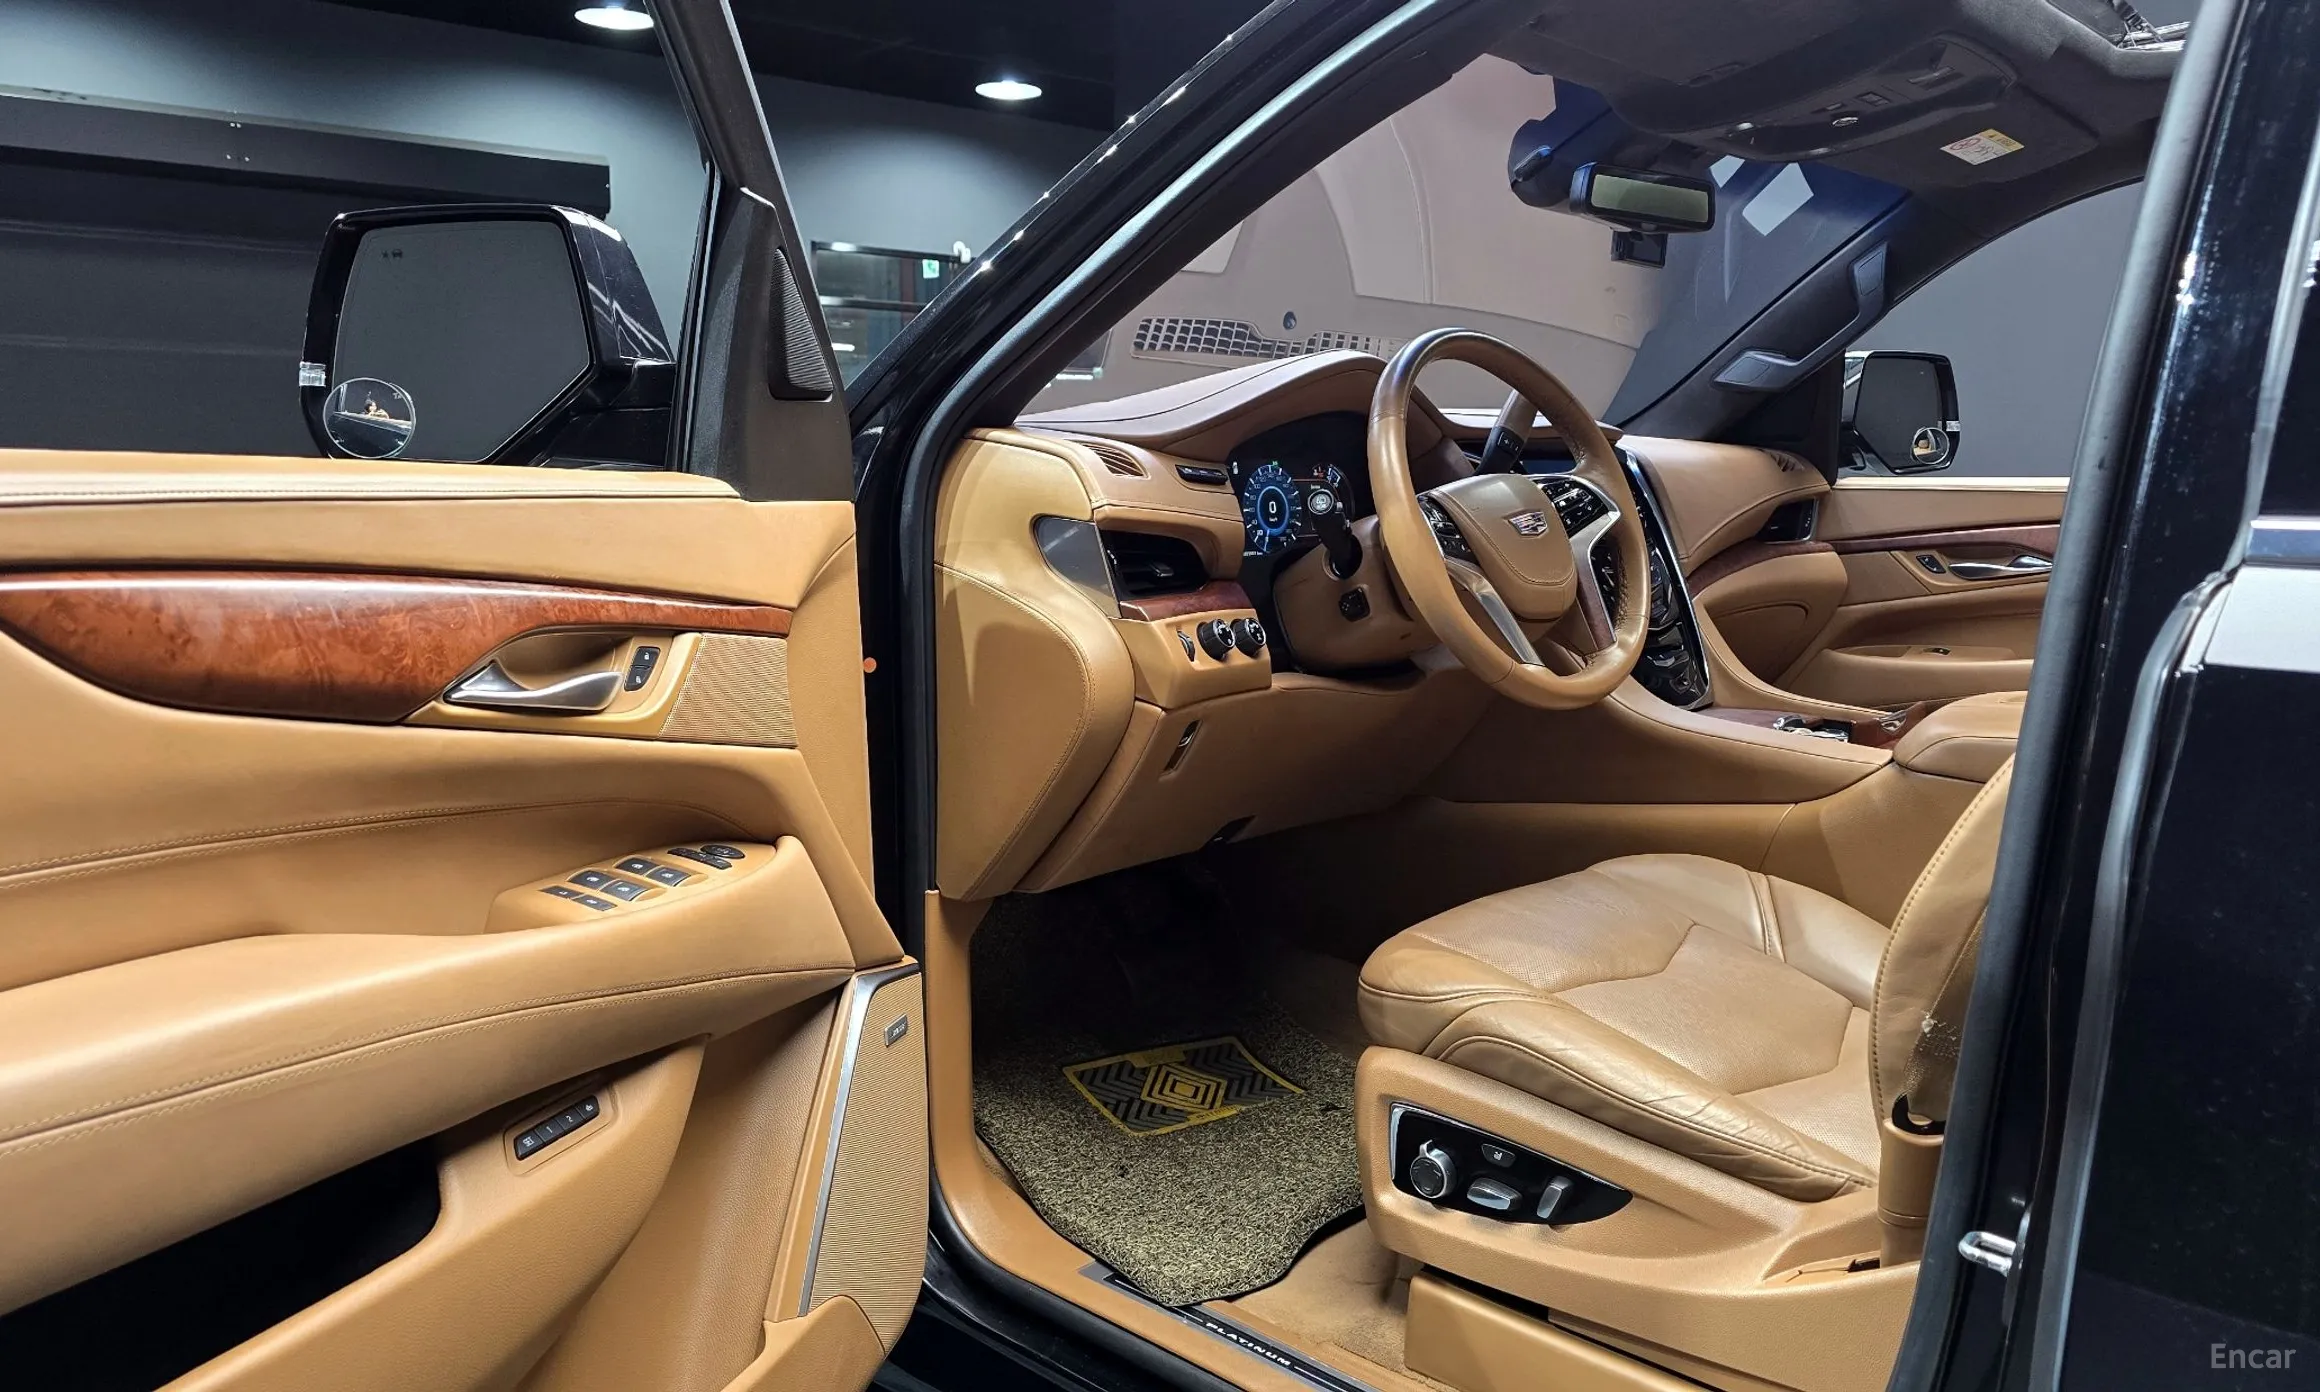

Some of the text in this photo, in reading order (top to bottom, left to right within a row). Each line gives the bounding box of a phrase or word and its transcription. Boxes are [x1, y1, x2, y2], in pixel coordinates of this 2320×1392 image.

[1269, 501, 1277, 514] 0
[565, 1115, 574, 1123] 2
[545, 1125, 553, 1134] 1
[1206, 1322, 1292, 1366] PLATINUM
